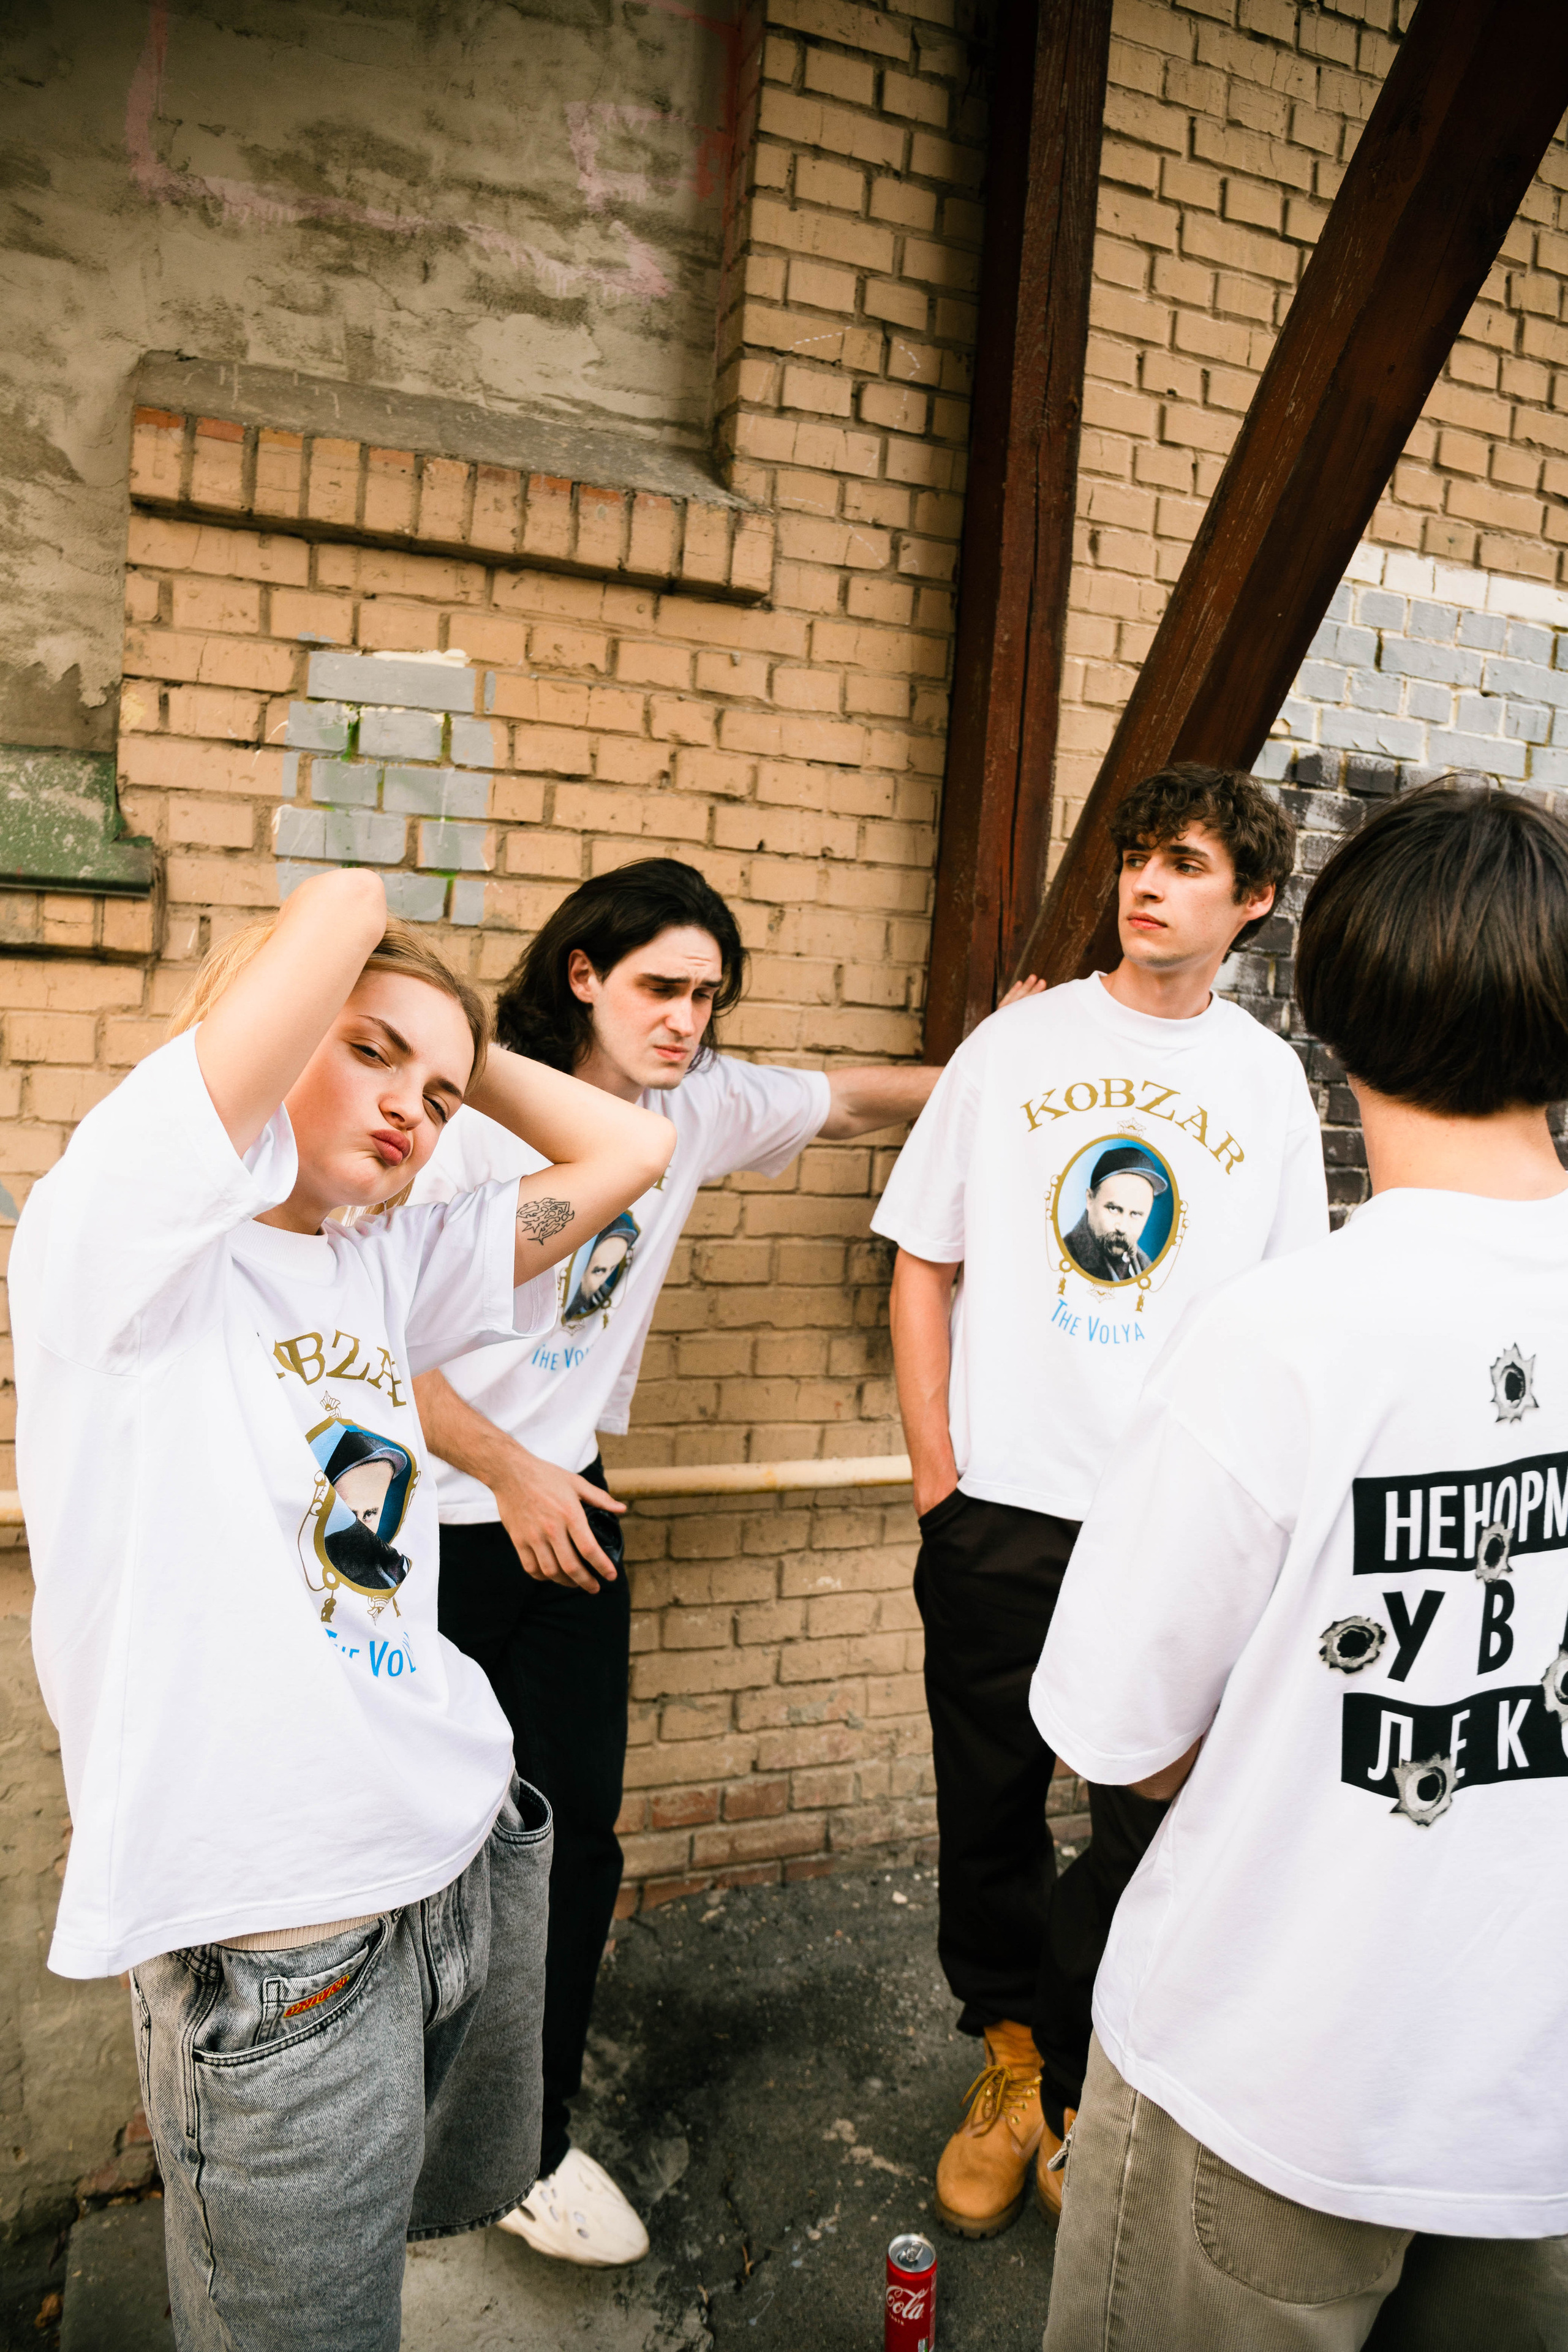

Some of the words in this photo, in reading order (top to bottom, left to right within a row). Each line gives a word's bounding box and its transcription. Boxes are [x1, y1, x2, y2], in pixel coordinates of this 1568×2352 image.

[1020, 1079, 1245, 1175] KOBZAR
[1051, 1299, 1082, 1336] THE
[1088, 1316, 1145, 1344] VOLYA
[1368, 1698, 1568, 1781] ЛЕК
[886, 2284, 930, 2320] Cola
